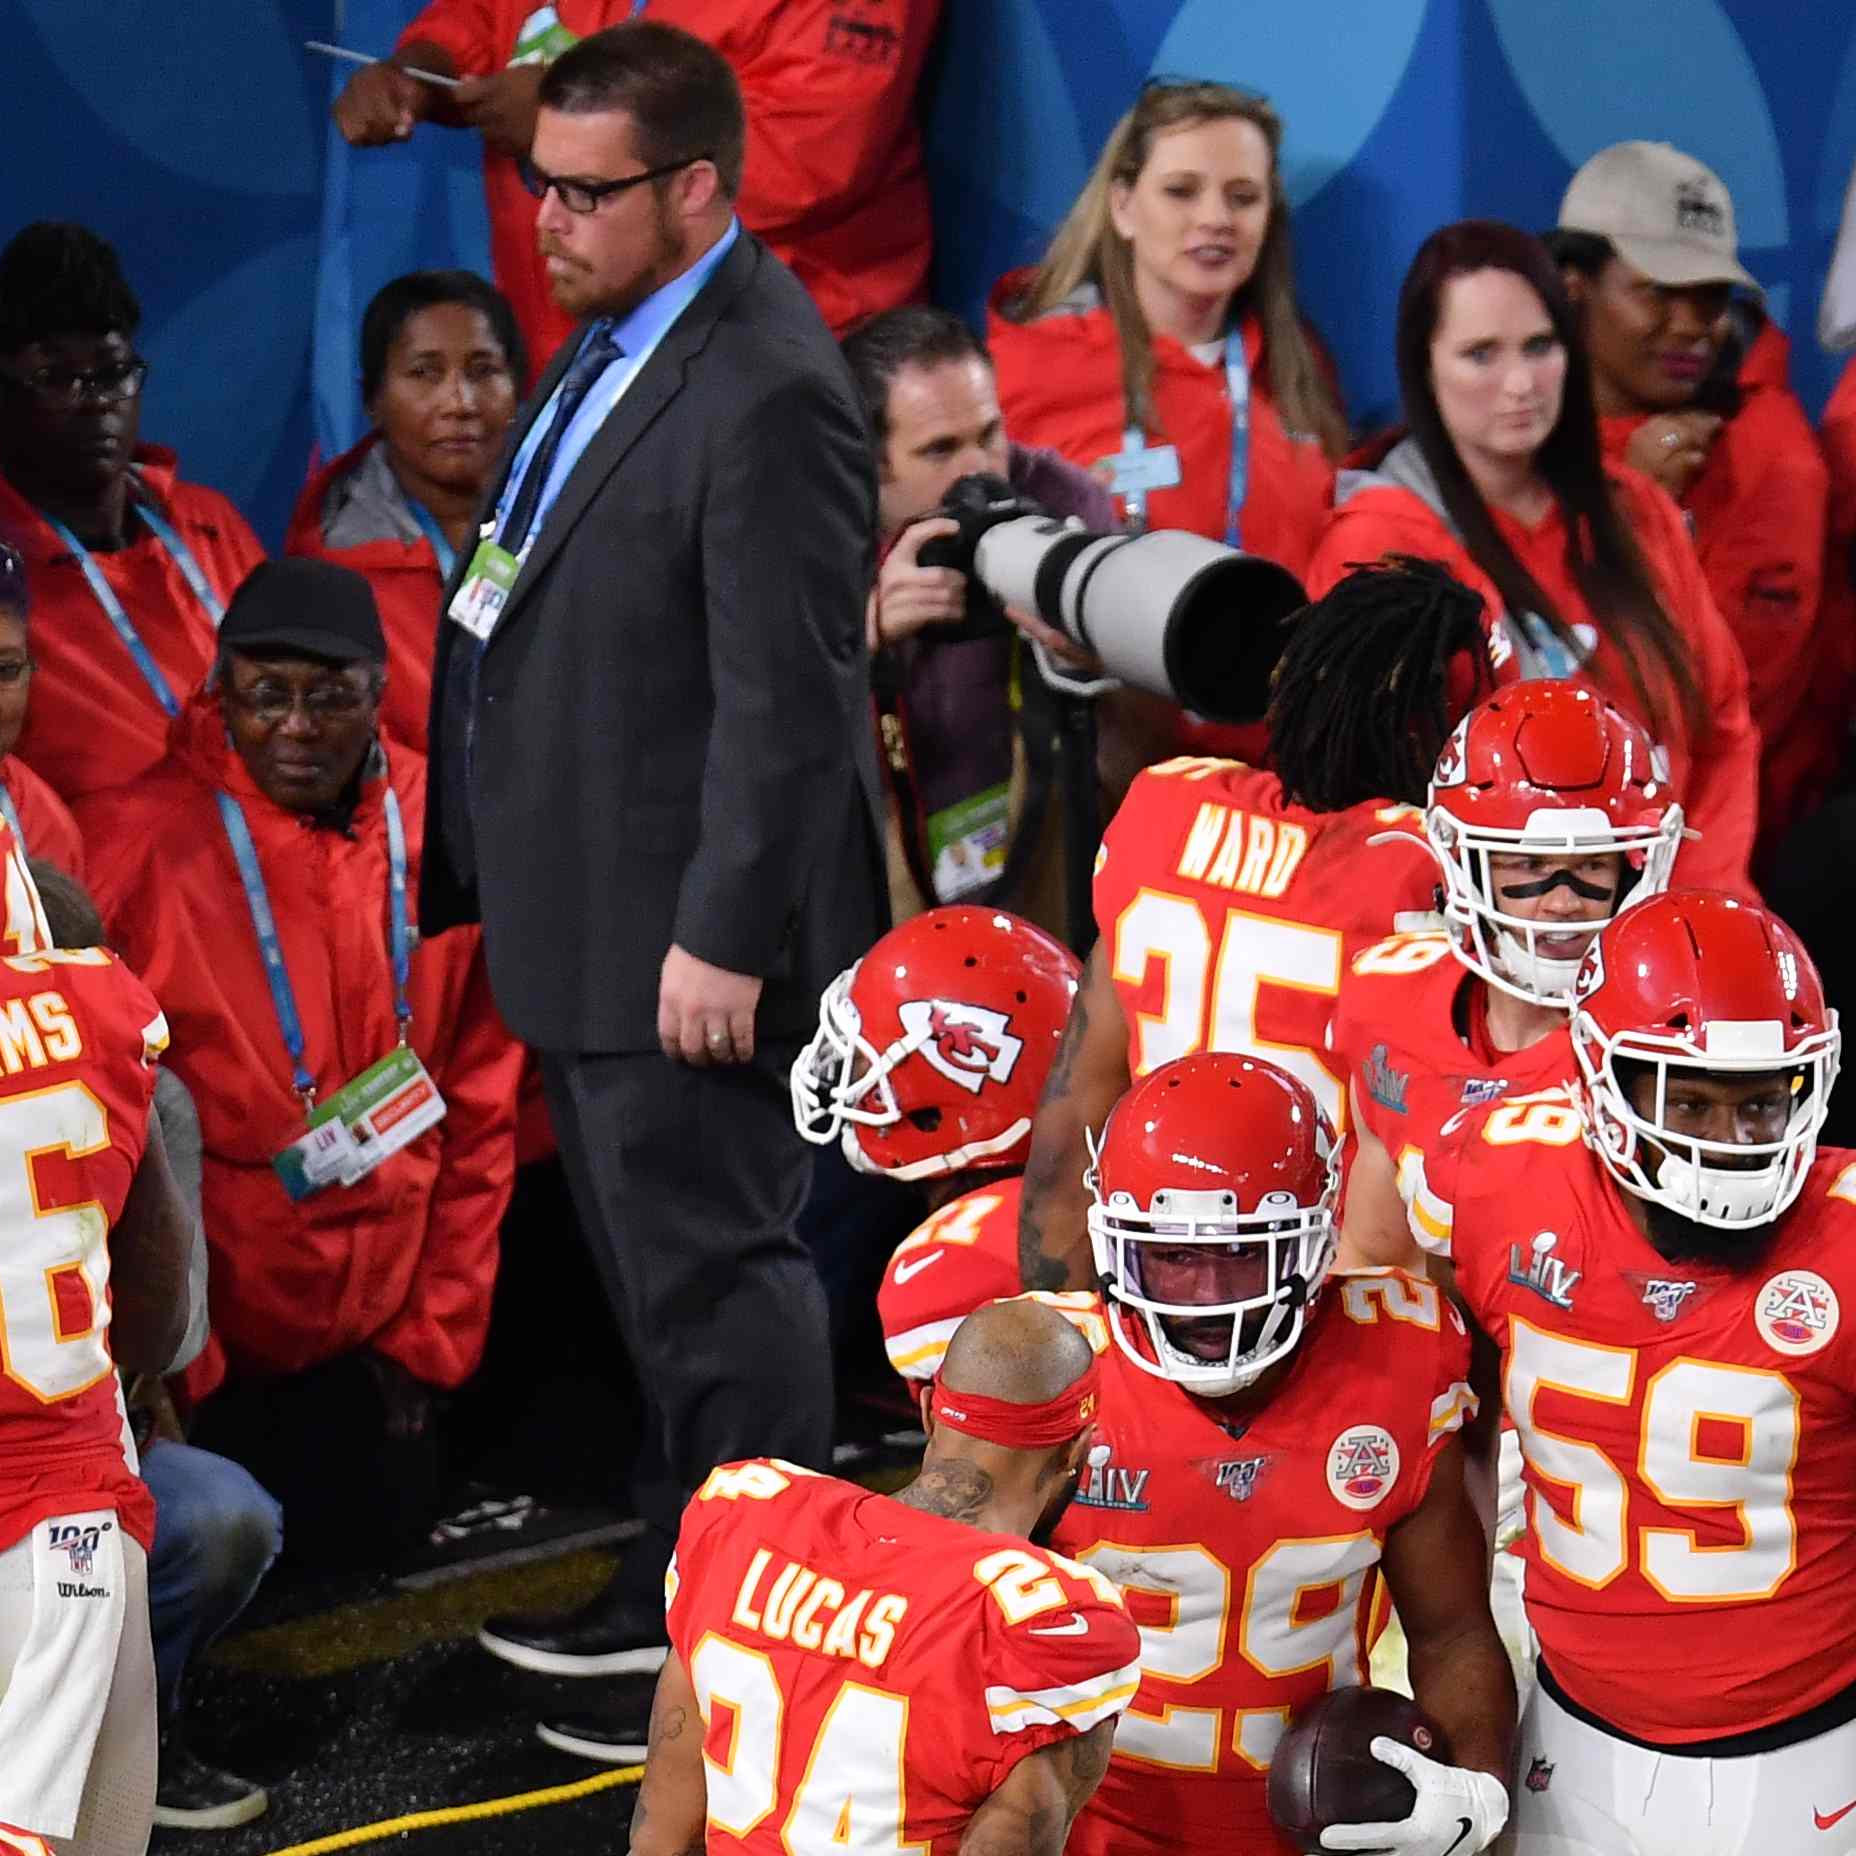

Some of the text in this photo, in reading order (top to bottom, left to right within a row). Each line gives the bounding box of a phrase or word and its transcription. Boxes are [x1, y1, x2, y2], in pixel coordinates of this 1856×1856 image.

[1176, 802, 1308, 897] WARD
[1111, 886, 1348, 1132] 35
[1764, 1278, 1827, 1329] A
[1335, 1435, 1390, 1478] A
[1503, 1312, 1802, 1605] 59
[731, 1547, 909, 1668] LUCAS
[1072, 1528, 1384, 1774] 29
